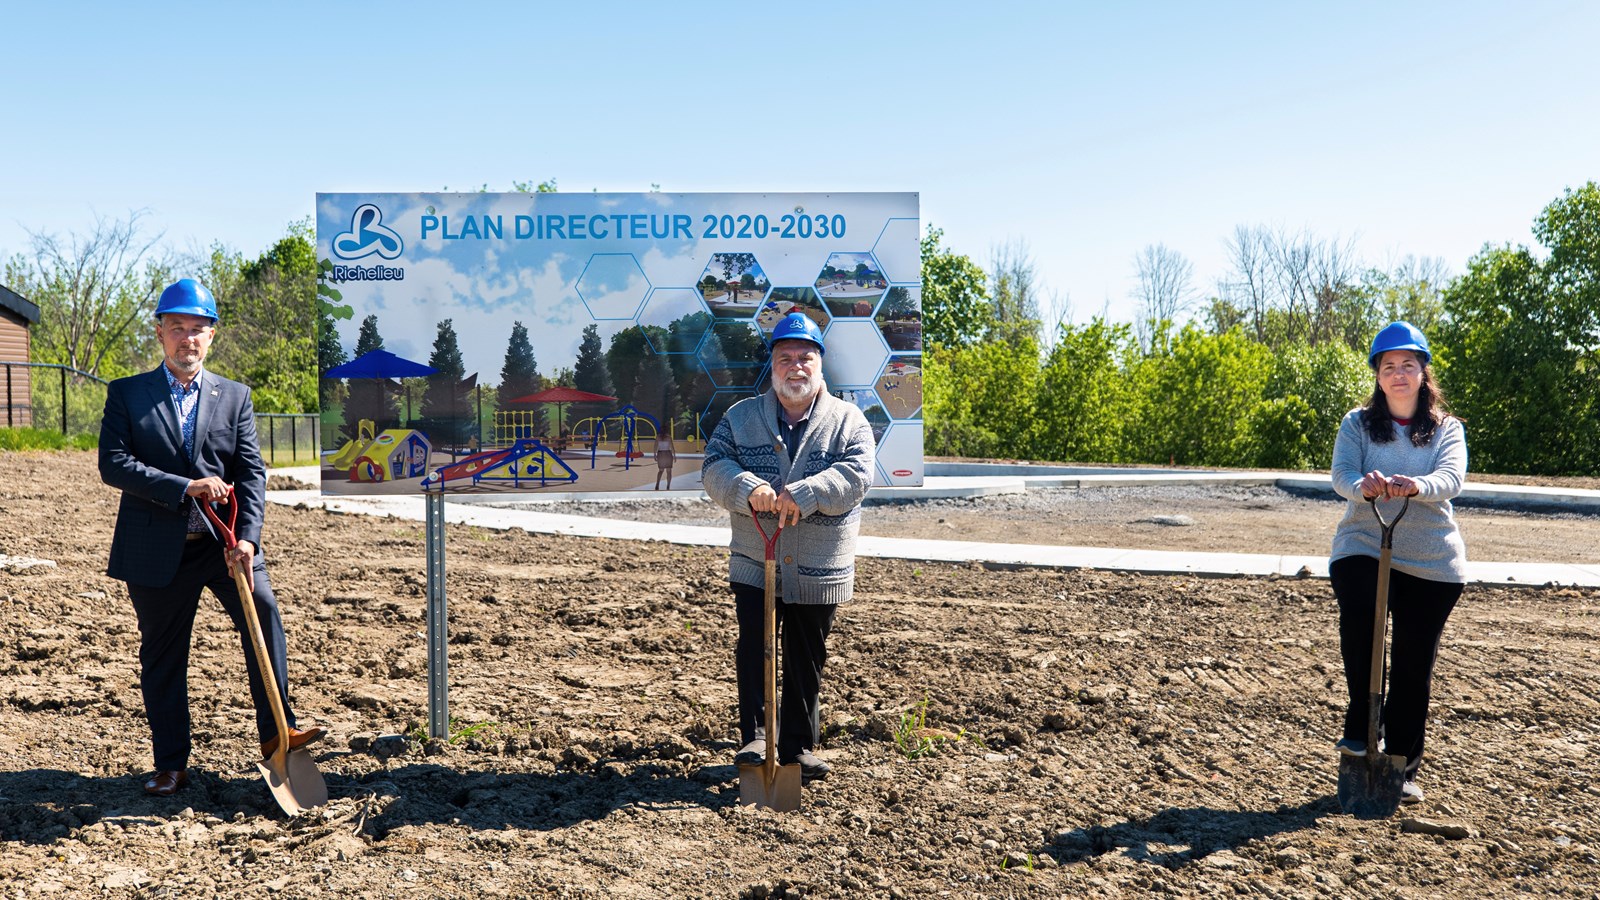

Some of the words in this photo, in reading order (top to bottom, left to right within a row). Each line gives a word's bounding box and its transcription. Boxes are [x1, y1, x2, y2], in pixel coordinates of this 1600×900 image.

[421, 215, 502, 240] PLAN
[515, 214, 693, 240] DIRECTEUR
[702, 214, 846, 239] 2020-2030
[333, 265, 404, 281] Richelieu
